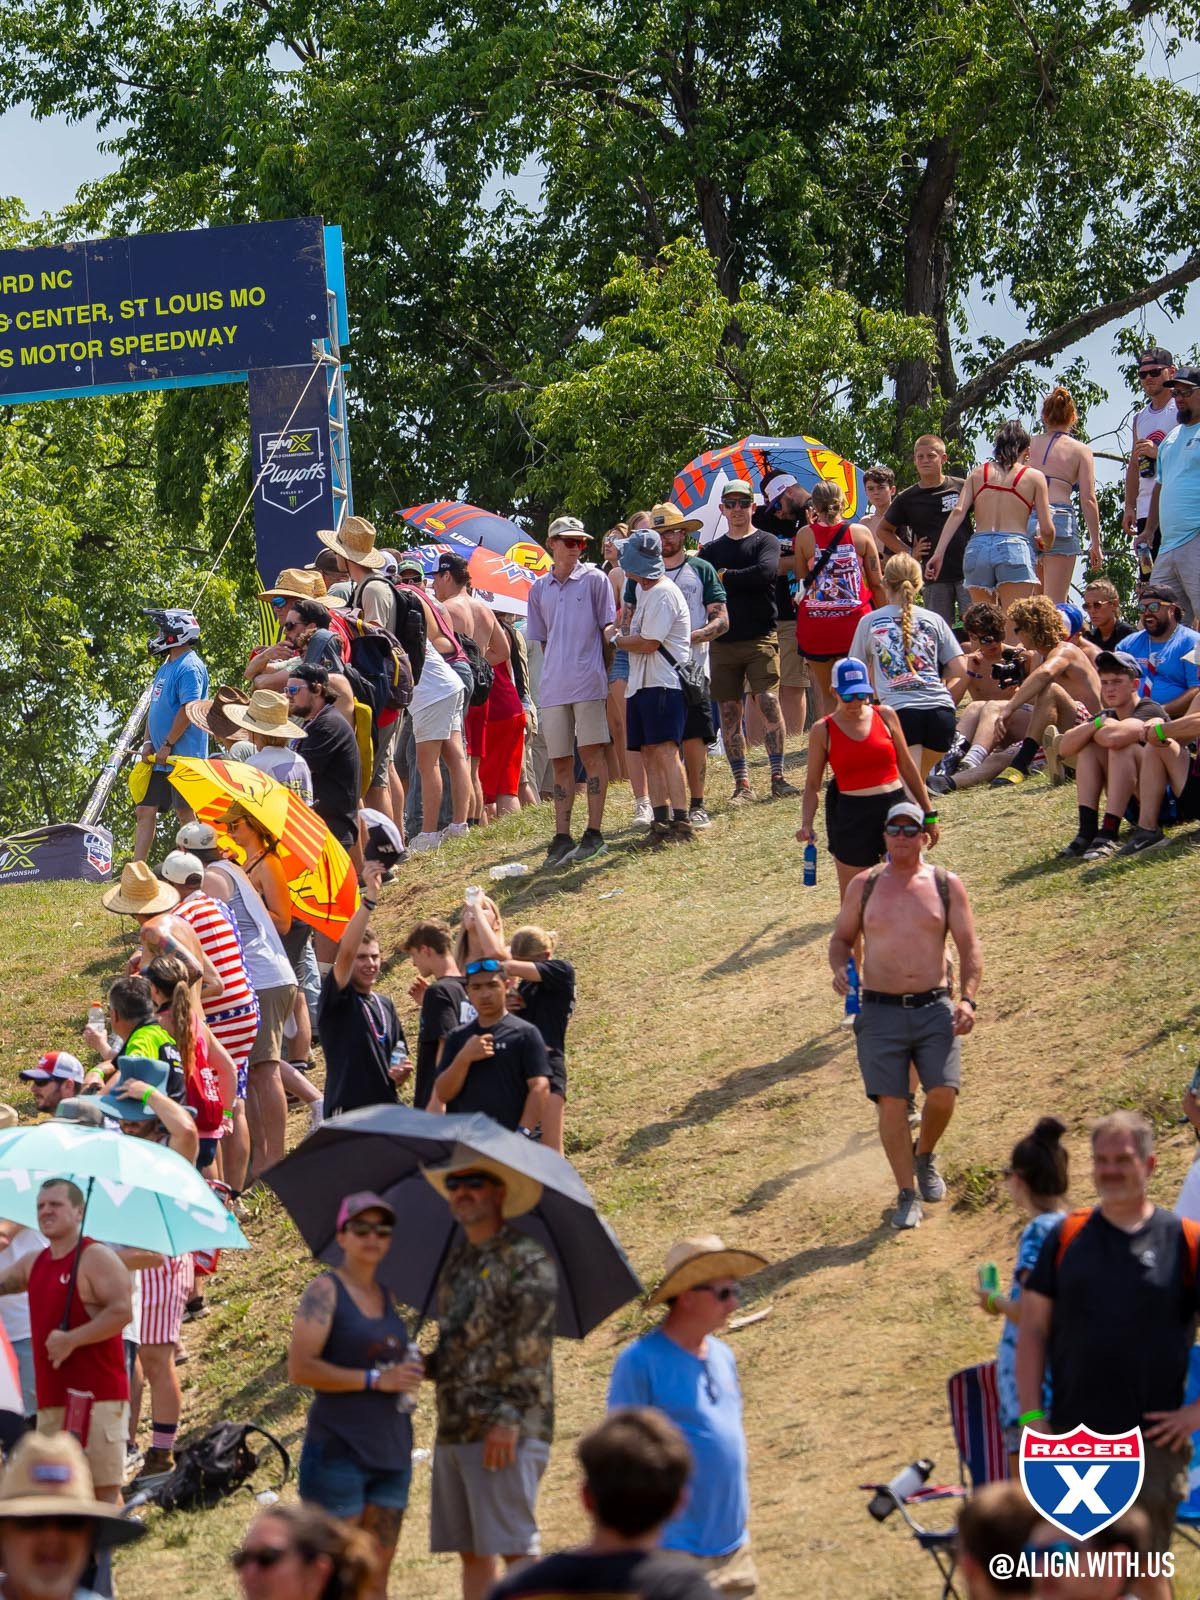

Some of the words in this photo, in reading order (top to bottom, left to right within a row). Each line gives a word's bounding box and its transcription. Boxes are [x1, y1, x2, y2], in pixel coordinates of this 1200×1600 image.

[40, 269, 73, 290] NC
[15, 302, 114, 331] CENTER,
[120, 298, 148, 319] ST
[155, 291, 223, 316] LOUIS
[230, 286, 266, 308] MO
[20, 340, 103, 366] MOTOR
[109, 326, 238, 357] SPEEDWAY
[266, 433, 312, 453] SMX
[257, 462, 326, 489] Playoffs
